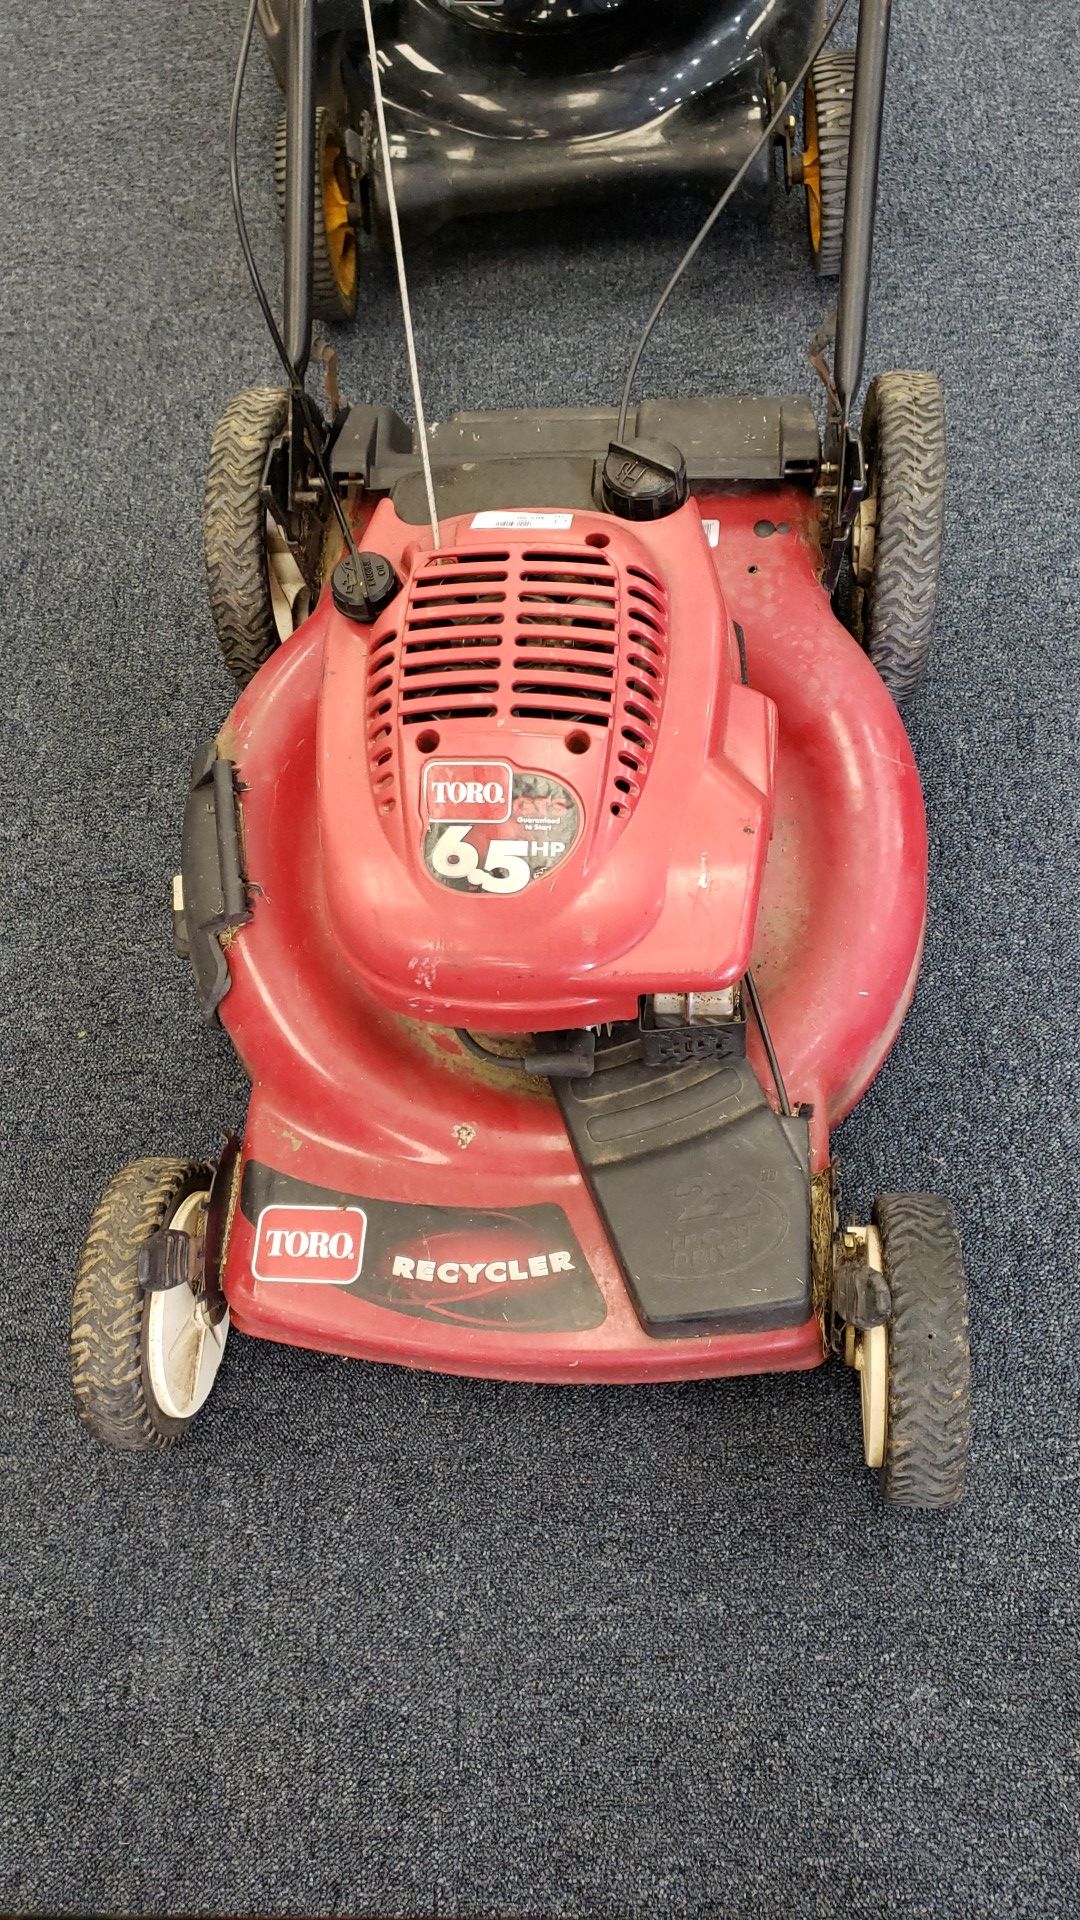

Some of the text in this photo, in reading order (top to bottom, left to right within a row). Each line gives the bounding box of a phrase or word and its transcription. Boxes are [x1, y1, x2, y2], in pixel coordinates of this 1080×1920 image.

[516, 816, 561, 825] Guaranteed
[534, 823, 552, 831] Start
[432, 825, 566, 894] 6.5 HP
[391, 1250, 577, 1285] RECYCLER
